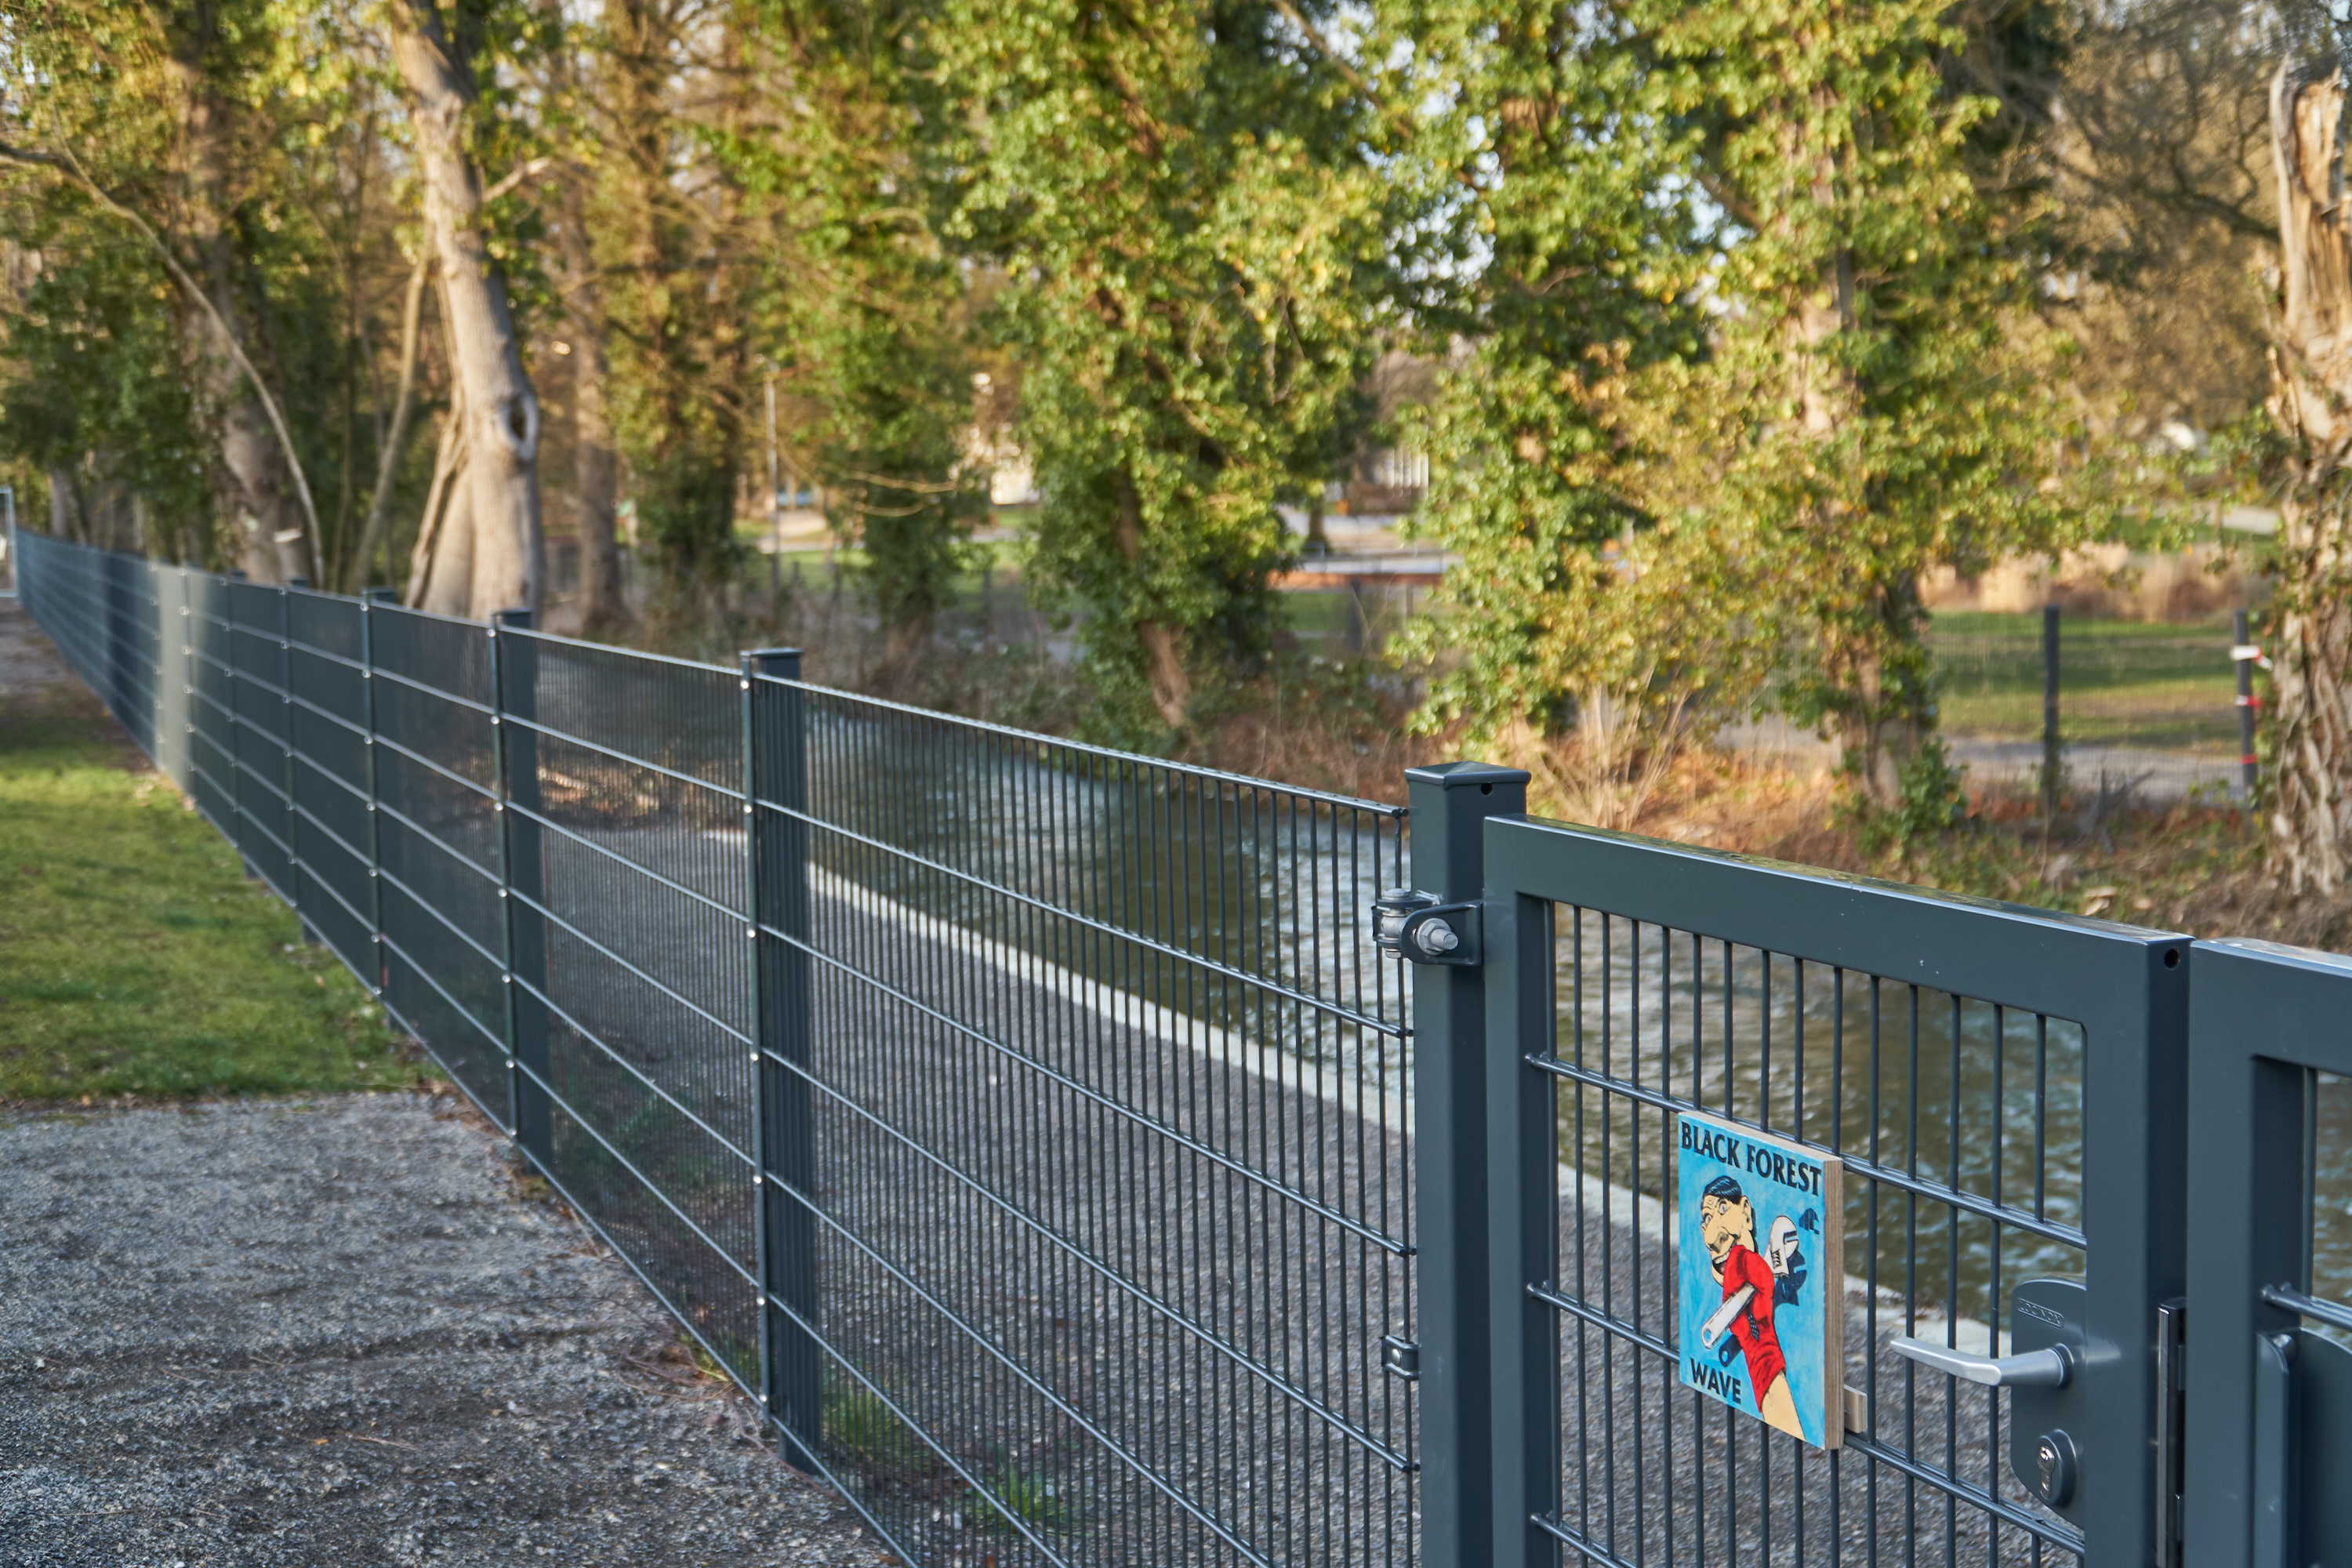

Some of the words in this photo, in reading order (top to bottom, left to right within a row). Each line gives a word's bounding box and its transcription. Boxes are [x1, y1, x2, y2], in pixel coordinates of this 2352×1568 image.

[1681, 1121, 1740, 1169] BLACK
[1747, 1144, 1822, 1196] FOREST
[1690, 1357, 1741, 1405] WAVE
